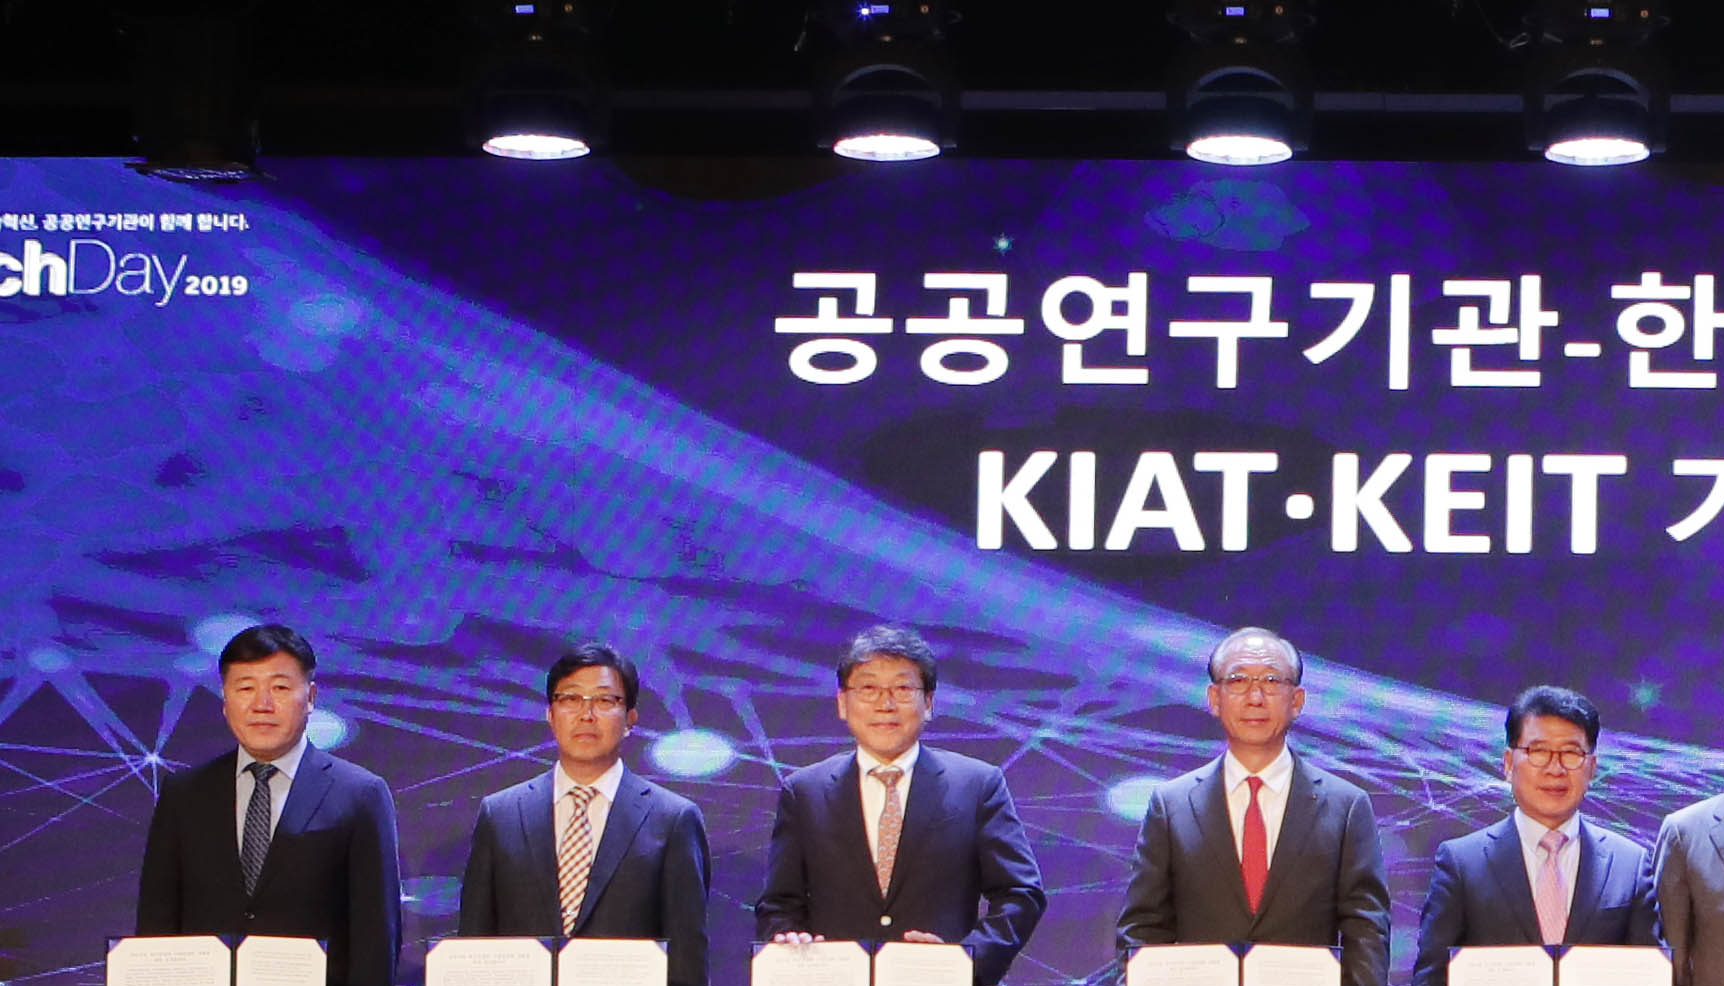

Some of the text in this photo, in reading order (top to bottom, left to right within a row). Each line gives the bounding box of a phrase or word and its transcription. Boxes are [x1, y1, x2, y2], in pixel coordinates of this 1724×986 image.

[42, 213, 155, 232] 공공연구기관이
[160, 212, 193, 232] 함께
[196, 212, 250, 232] 합니다.
[184, 274, 249, 296] 2019
